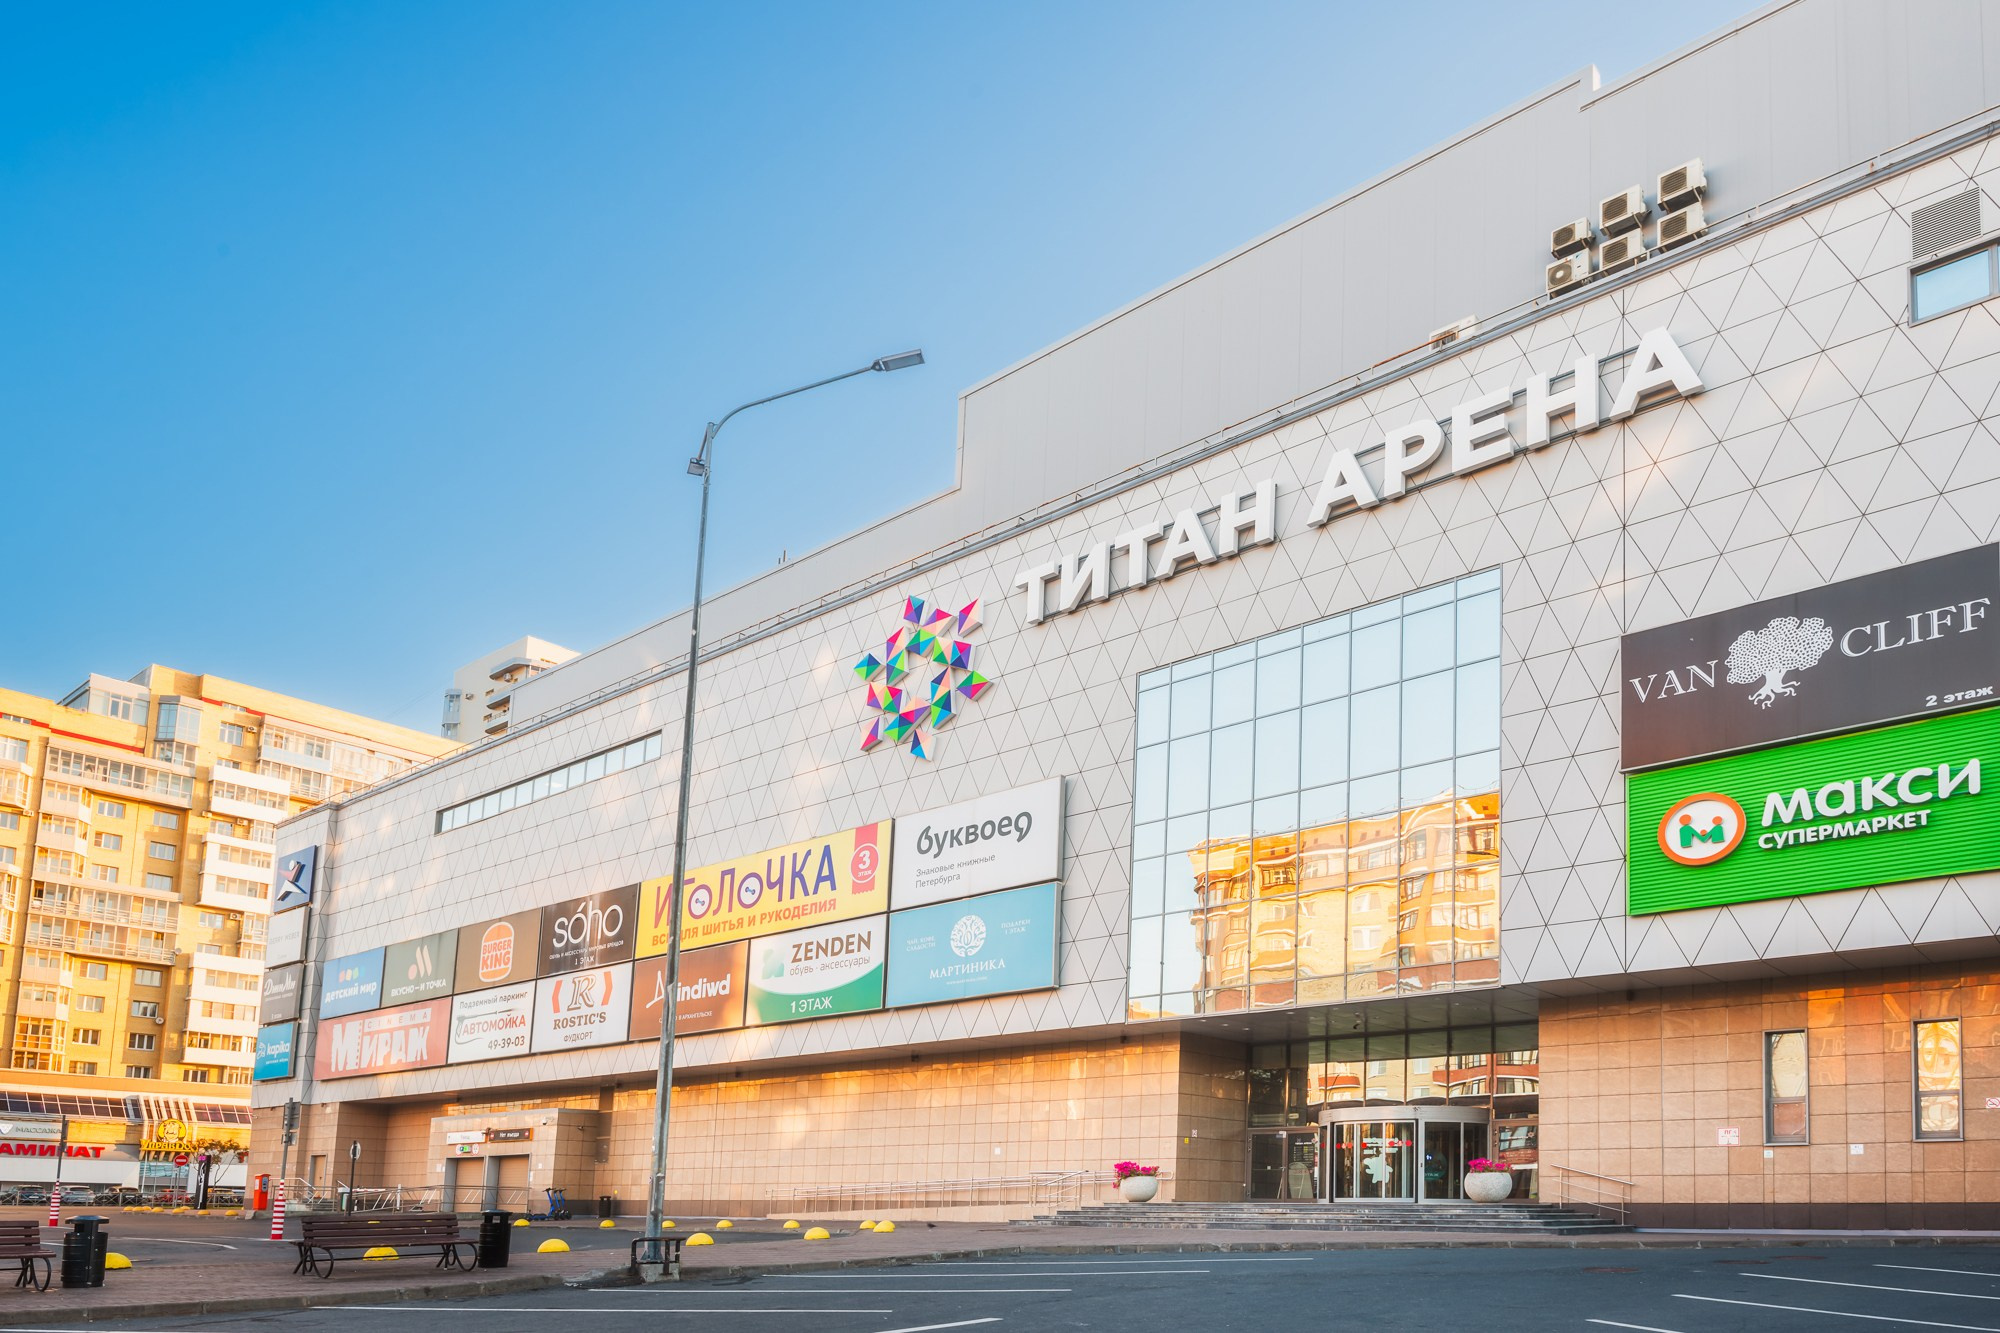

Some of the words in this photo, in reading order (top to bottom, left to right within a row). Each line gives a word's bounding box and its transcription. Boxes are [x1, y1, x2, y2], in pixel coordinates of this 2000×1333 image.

[1015, 478, 1276, 625] ТИТАН
[1306, 326, 1705, 528] АРЕНА
[1629, 660, 1718, 703] VAN
[1840, 598, 1990, 657] CLIFF
[1926, 695, 1938, 706] 2
[1943, 685, 1994, 704] этаж
[1758, 809, 1931, 850] СУПЕРМАРКЕТ
[858, 849, 871, 870] 3
[916, 862, 954, 877] Знаковые
[957, 854, 996, 868] книжные
[915, 873, 961, 888] Петербурга
[702, 917, 744, 936] ШИТЬЯ
[747, 915, 756, 927] И
[760, 898, 837, 925] РУКОДЕЛИЯ
[482, 939, 512, 954] BURGER
[791, 930, 872, 963] ZENDEN
[481, 952, 511, 971] KING
[790, 965, 814, 976] обувь
[820, 956, 871, 972] аксессуары
[929, 957, 1006, 979] МАРТИНИКА
[325, 983, 359, 1003] детский
[360, 982, 377, 996] мир
[391, 986, 414, 997] ВКУСНО
[426, 979, 446, 990] ТОЧКА
[460, 995, 498, 1009] Подземный
[499, 991, 528, 1004] паркинг
[791, 1002, 796, 1013] 1
[799, 996, 833, 1013] ЭТАЖ
[368, 1012, 428, 1029] CINEMA
[463, 1014, 526, 1036] АВТОМОЙКА
[553, 1011, 607, 1030] ROSTIC'S
[331, 1020, 430, 1072] МИРАЖ
[488, 1036, 525, 1050] 49-39-03
[563, 1031, 593, 1042] ФУДКОРТ
